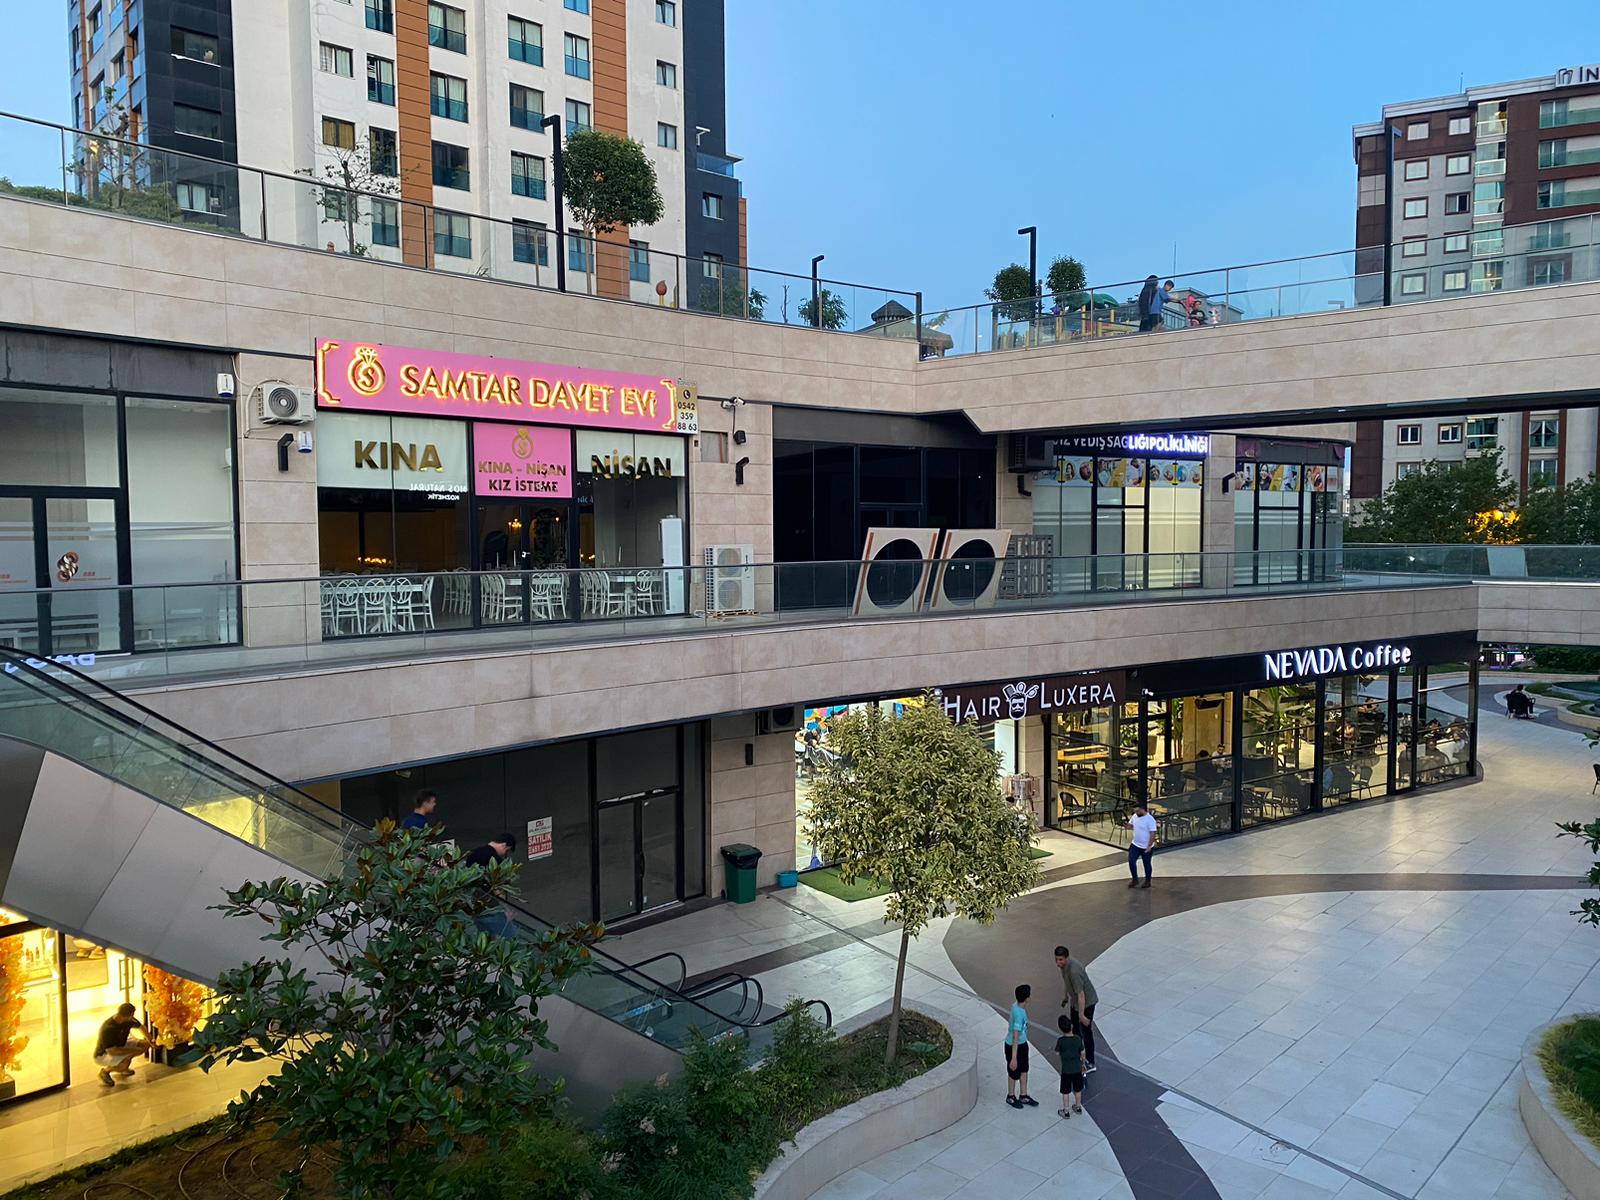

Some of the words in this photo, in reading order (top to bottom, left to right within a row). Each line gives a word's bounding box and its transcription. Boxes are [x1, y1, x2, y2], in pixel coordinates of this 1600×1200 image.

[401, 365, 522, 406] SAMTAR
[529, 378, 615, 413] DAVET
[678, 402, 695, 410] 0542
[680, 412, 694, 420] 359
[678, 422, 686, 430] 88
[688, 423, 697, 431] 63
[354, 440, 444, 473] KINA
[479, 461, 513, 473] KINA
[526, 460, 566, 477] NİŞAN
[489, 479, 511, 491] KIZ
[515, 476, 558, 492] İSTEME
[1265, 646, 1347, 681] NEVADA
[1352, 644, 1411, 669] Coffee
[943, 695, 1000, 723] HAIR
[1041, 682, 1116, 709] LUXERA
[528, 833, 552, 846] SATILIK
